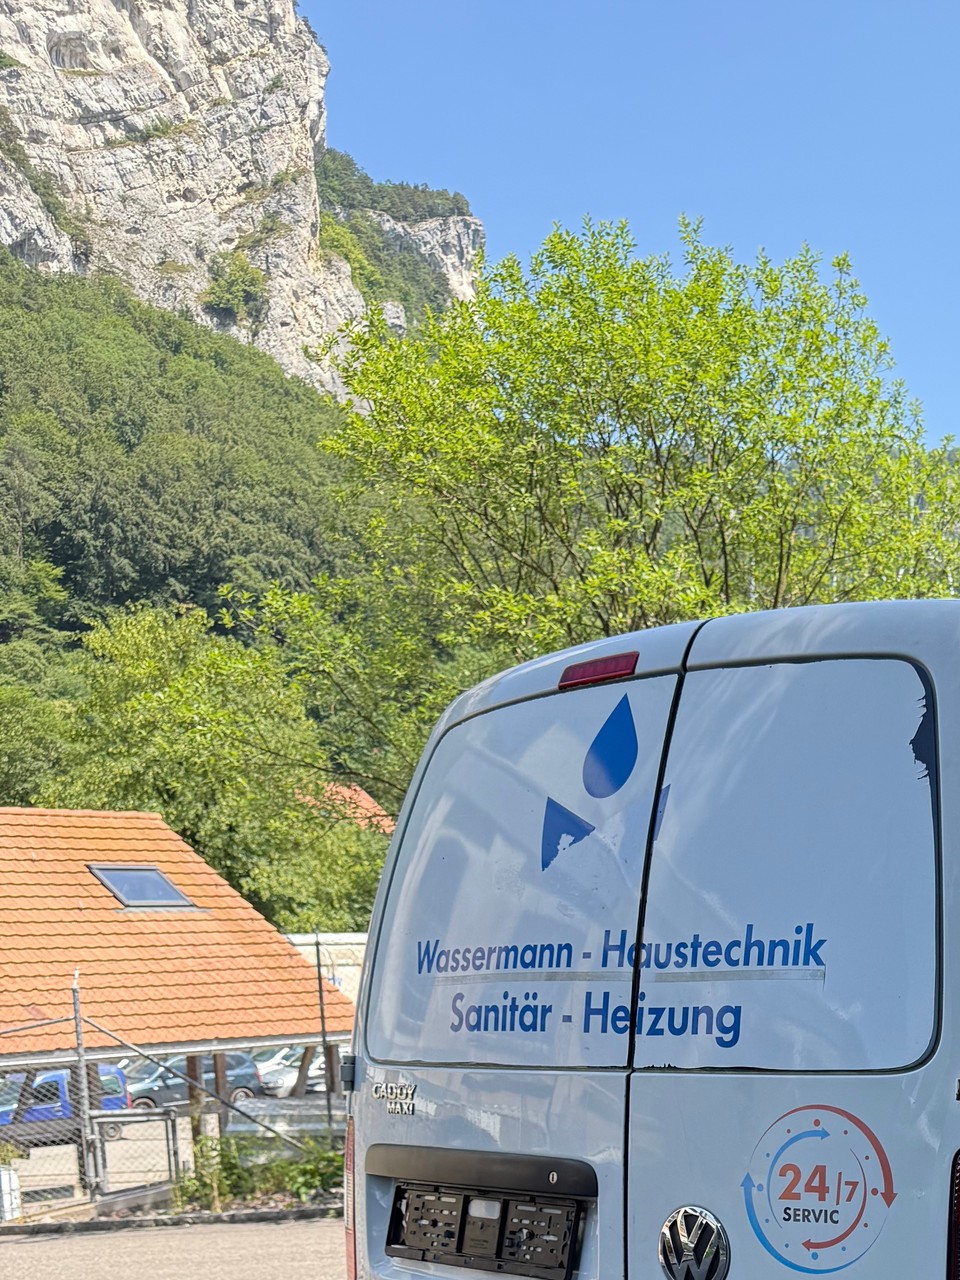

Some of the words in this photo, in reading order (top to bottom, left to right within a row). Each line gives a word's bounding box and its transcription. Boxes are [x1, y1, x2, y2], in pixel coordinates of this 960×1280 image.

[417, 939, 573, 974] Wassermann
[601, 922, 827, 970] Haustechnik
[450, 991, 553, 1033] Sanitär
[583, 991, 742, 1049] Heizung
[372, 1083, 417, 1101] CADDY
[387, 1101, 415, 1116] MAXI
[778, 1163, 860, 1206] 24/7
[782, 1206, 840, 1226] SERVIC
